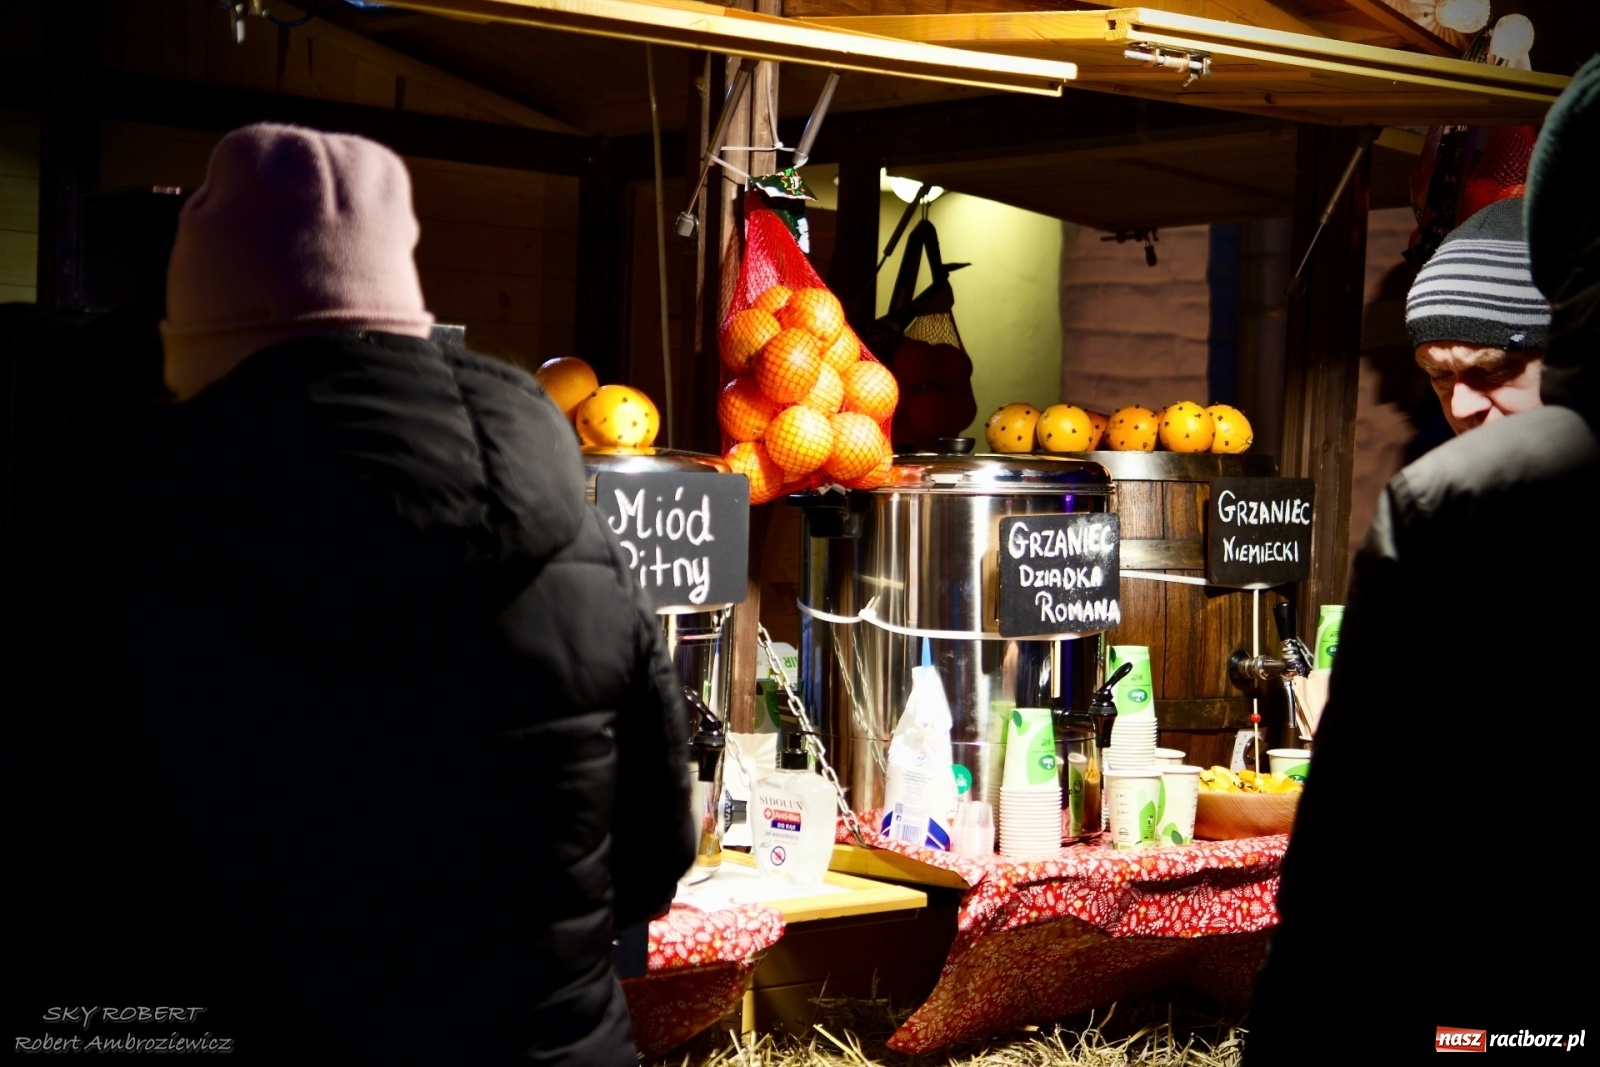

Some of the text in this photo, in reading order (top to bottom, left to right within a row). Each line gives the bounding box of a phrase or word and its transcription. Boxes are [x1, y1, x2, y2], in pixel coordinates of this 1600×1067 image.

[608, 486, 715, 546] Miód
[1218, 490, 1310, 527] GRZANIEC
[1008, 521, 1115, 559] GRZANIEC
[1223, 536, 1299, 565] NIEMIECKI
[1019, 564, 1104, 590] DZIADKA
[1035, 591, 1121, 624] ROMANA
[759, 796, 802, 810] SIDOLUX
[785, 823, 796, 831] RĄK
